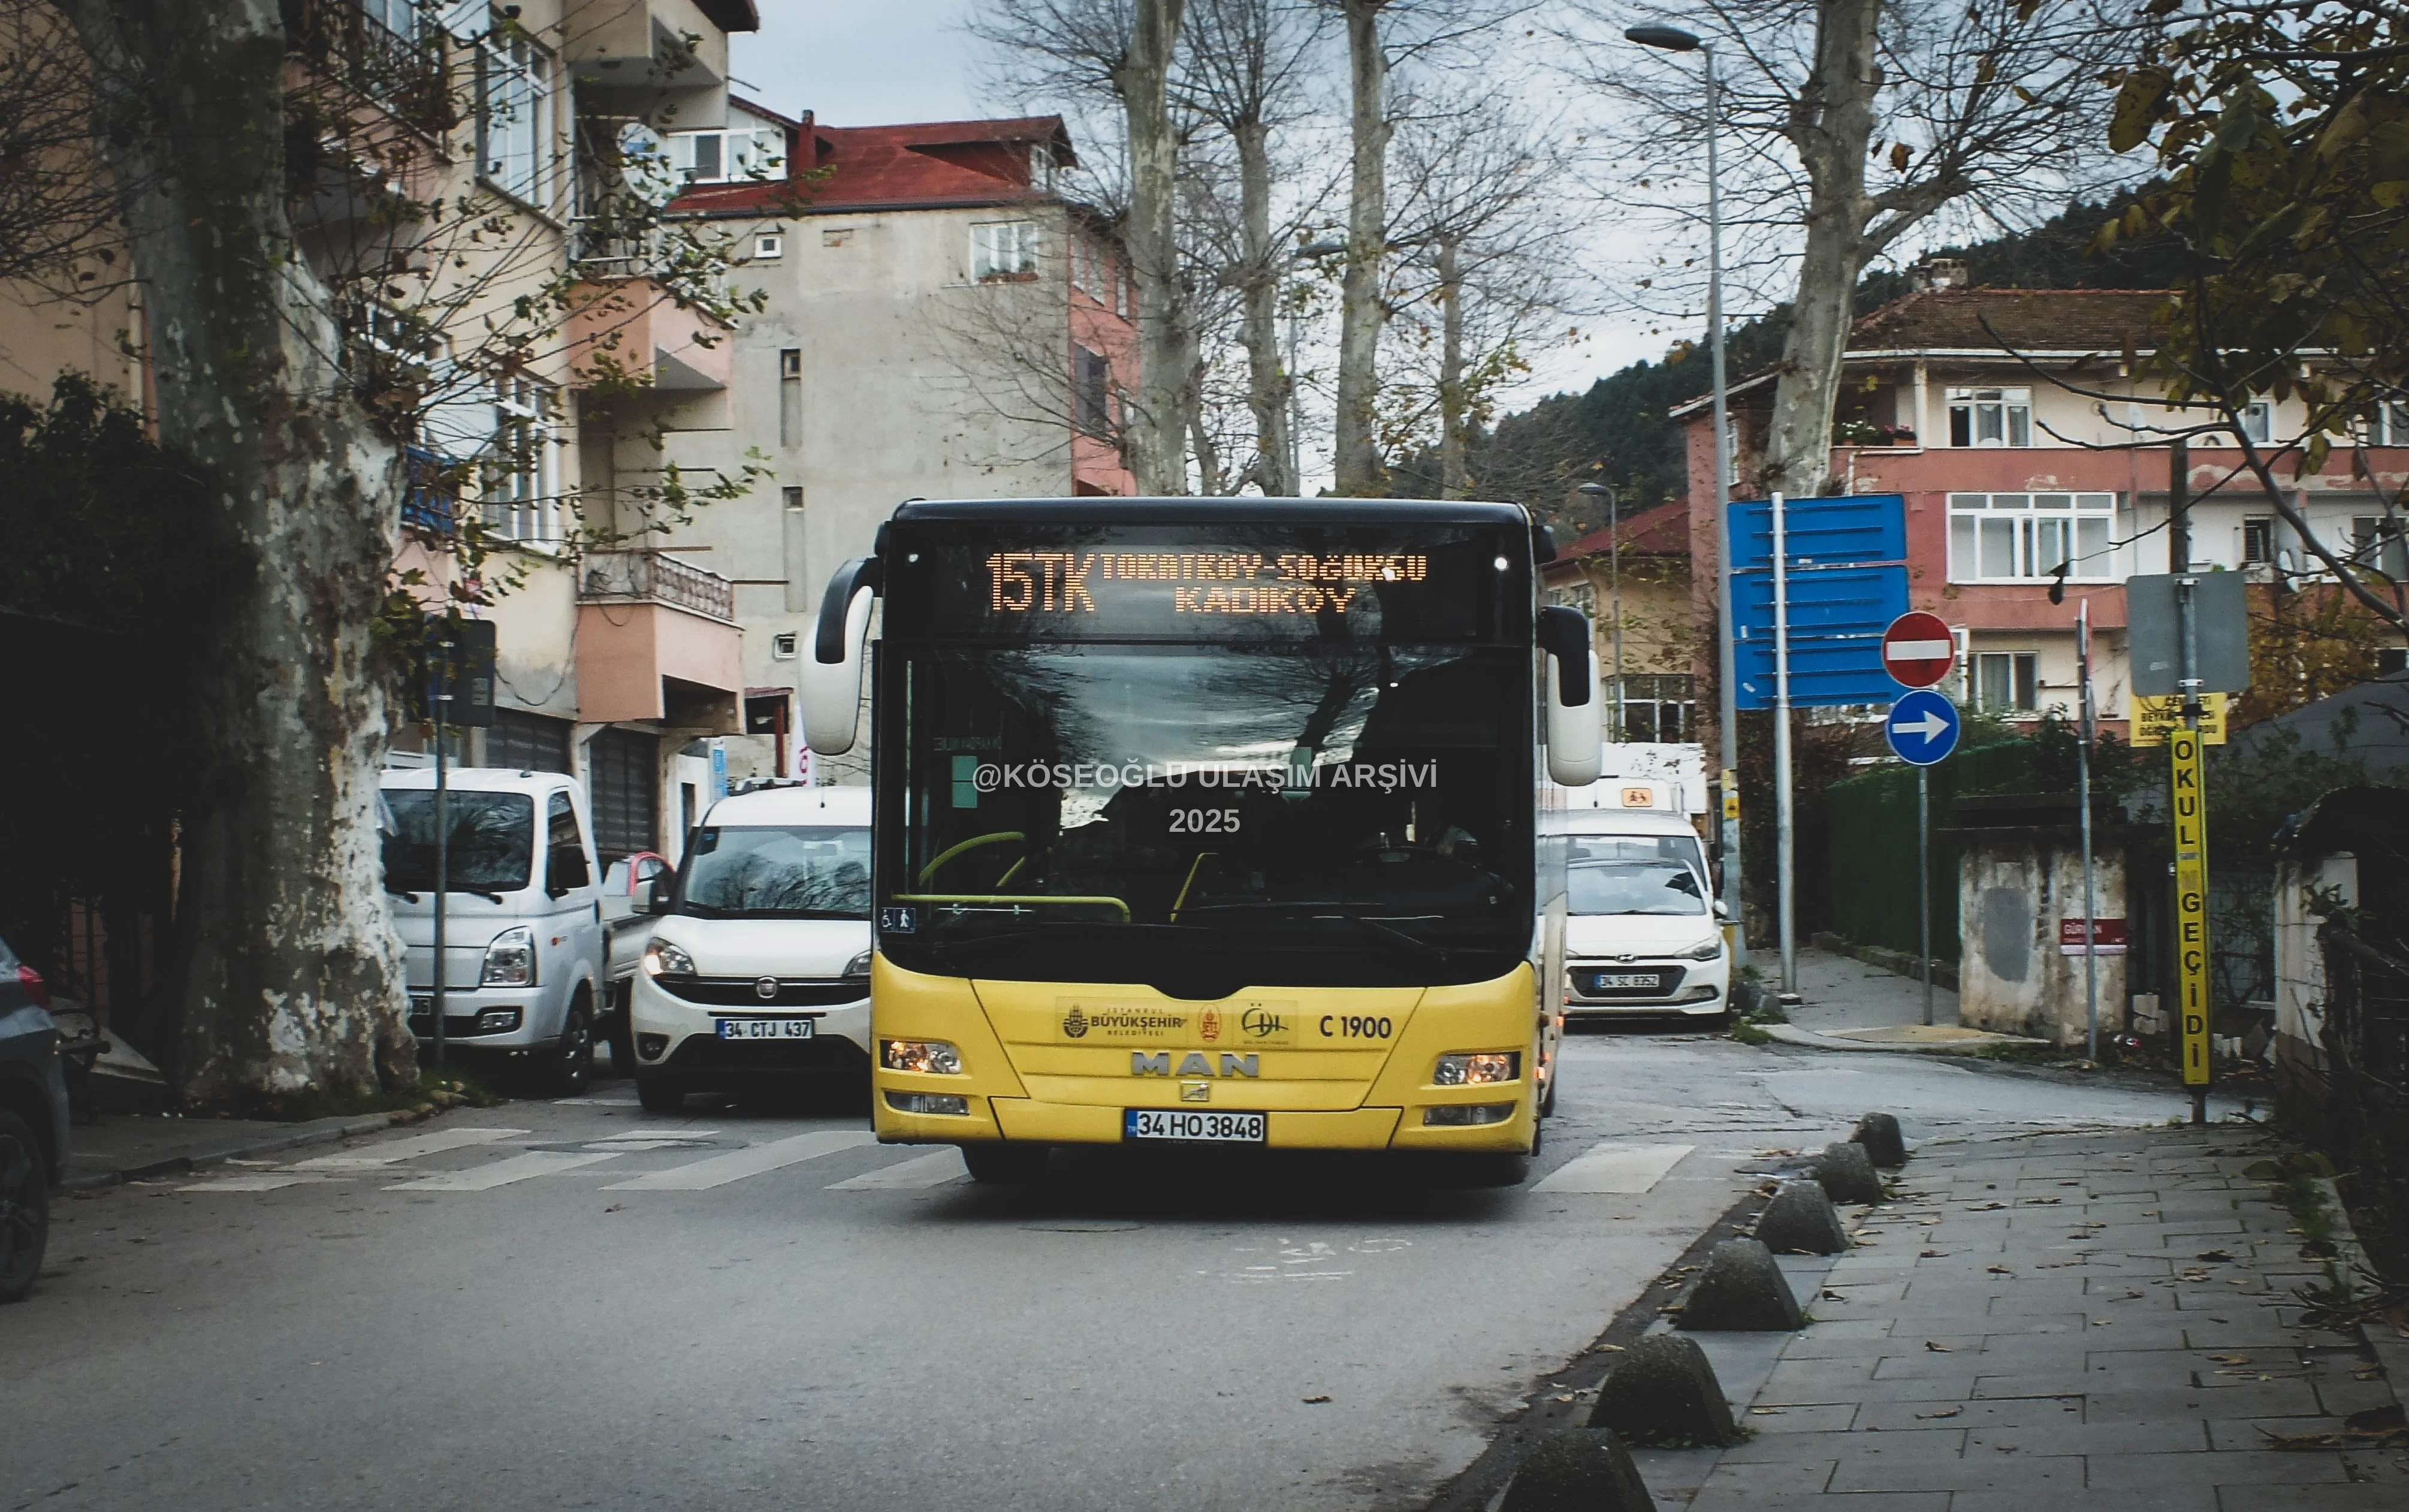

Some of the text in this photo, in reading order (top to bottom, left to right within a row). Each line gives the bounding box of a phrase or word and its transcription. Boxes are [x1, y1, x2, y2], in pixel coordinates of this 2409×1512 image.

[986, 553, 1095, 611] 15TK
[1176, 587, 1356, 613] KADIKÖY
[2175, 740, 2203, 1068] OKUL GEÇİDİ
[726, 1022, 810, 1038] 34 CTJ 437
[1091, 1013, 1182, 1029] BÜYÜKŞEHİR
[1320, 1015, 1391, 1039] C 1900
[1132, 1051, 1259, 1078] MAN
[1139, 1113, 1164, 1136] 34
[1170, 1115, 1202, 1137] HO
[1206, 1116, 1261, 1139] 3848
